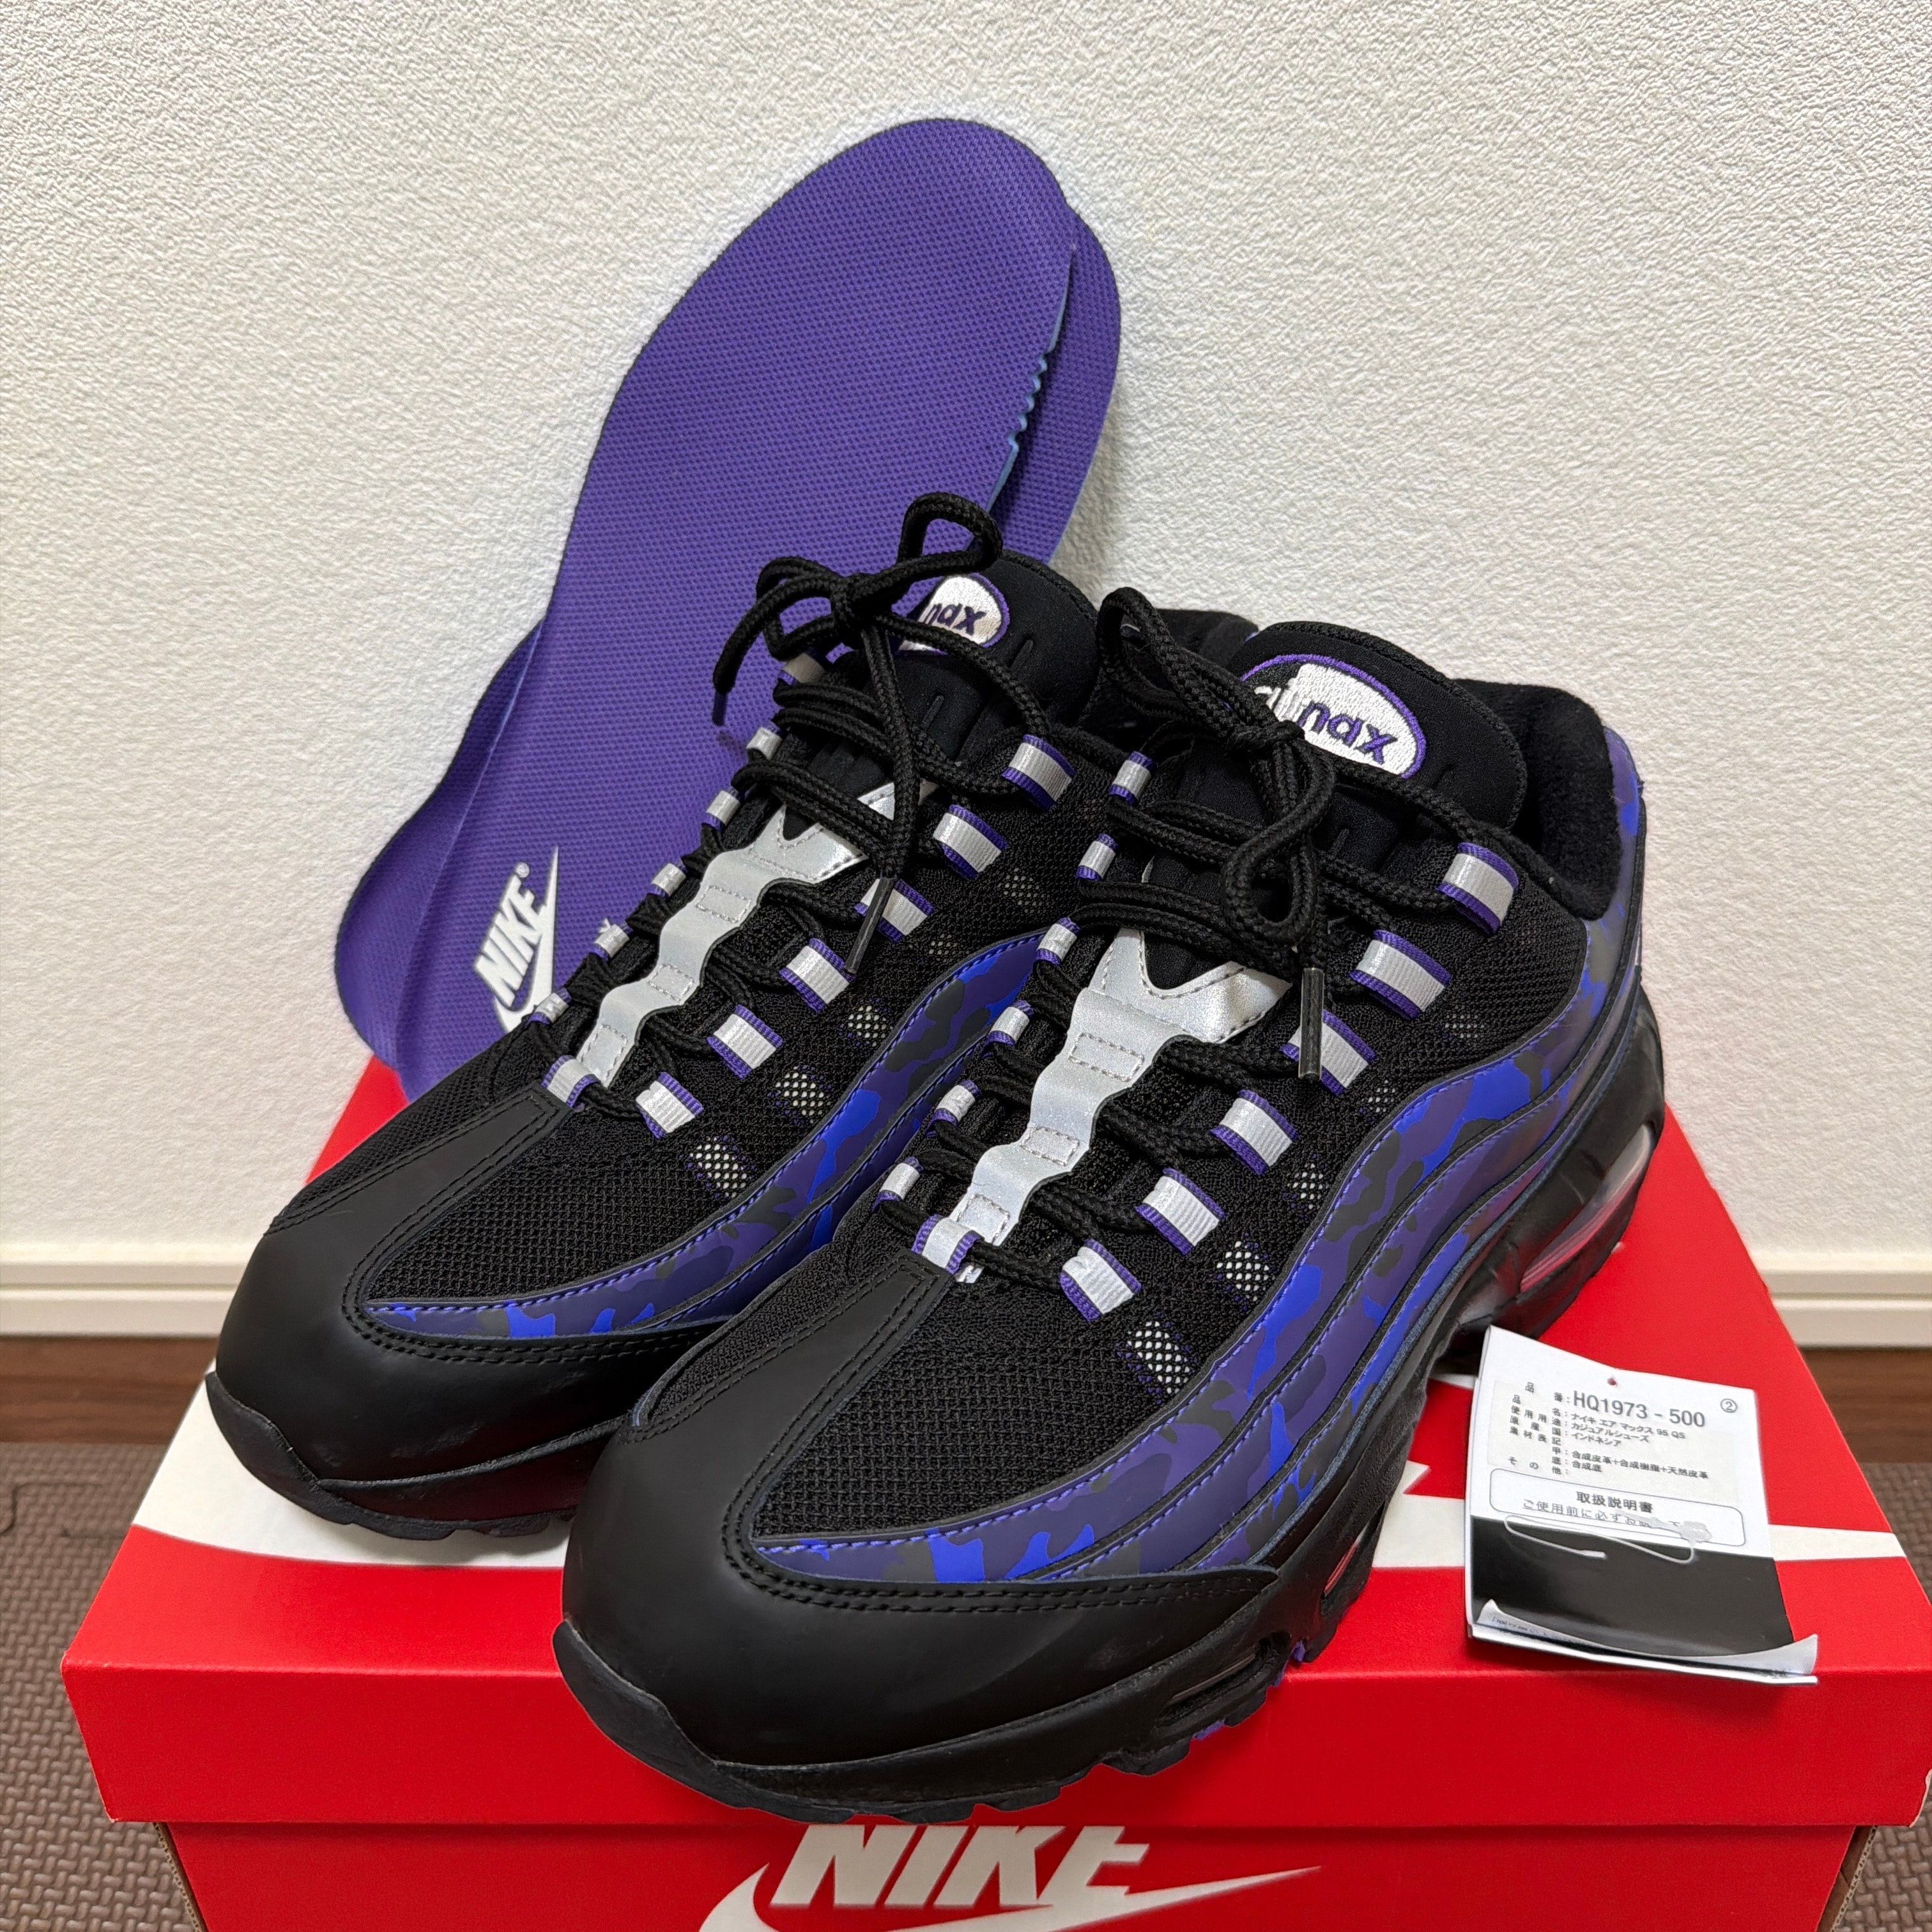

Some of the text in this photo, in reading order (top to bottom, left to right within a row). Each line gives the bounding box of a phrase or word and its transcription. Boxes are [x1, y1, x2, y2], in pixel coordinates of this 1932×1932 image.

[473, 873, 547, 1008] NIKE
[1573, 1390, 1648, 1419] HQ1973
[1669, 1408, 1705, 1427] 500
[1571, 1432, 1621, 1447] インドネシア
[1575, 1491, 1653, 1514] 取扱説明書
[769, 1825, 1150, 1907] NIKE
